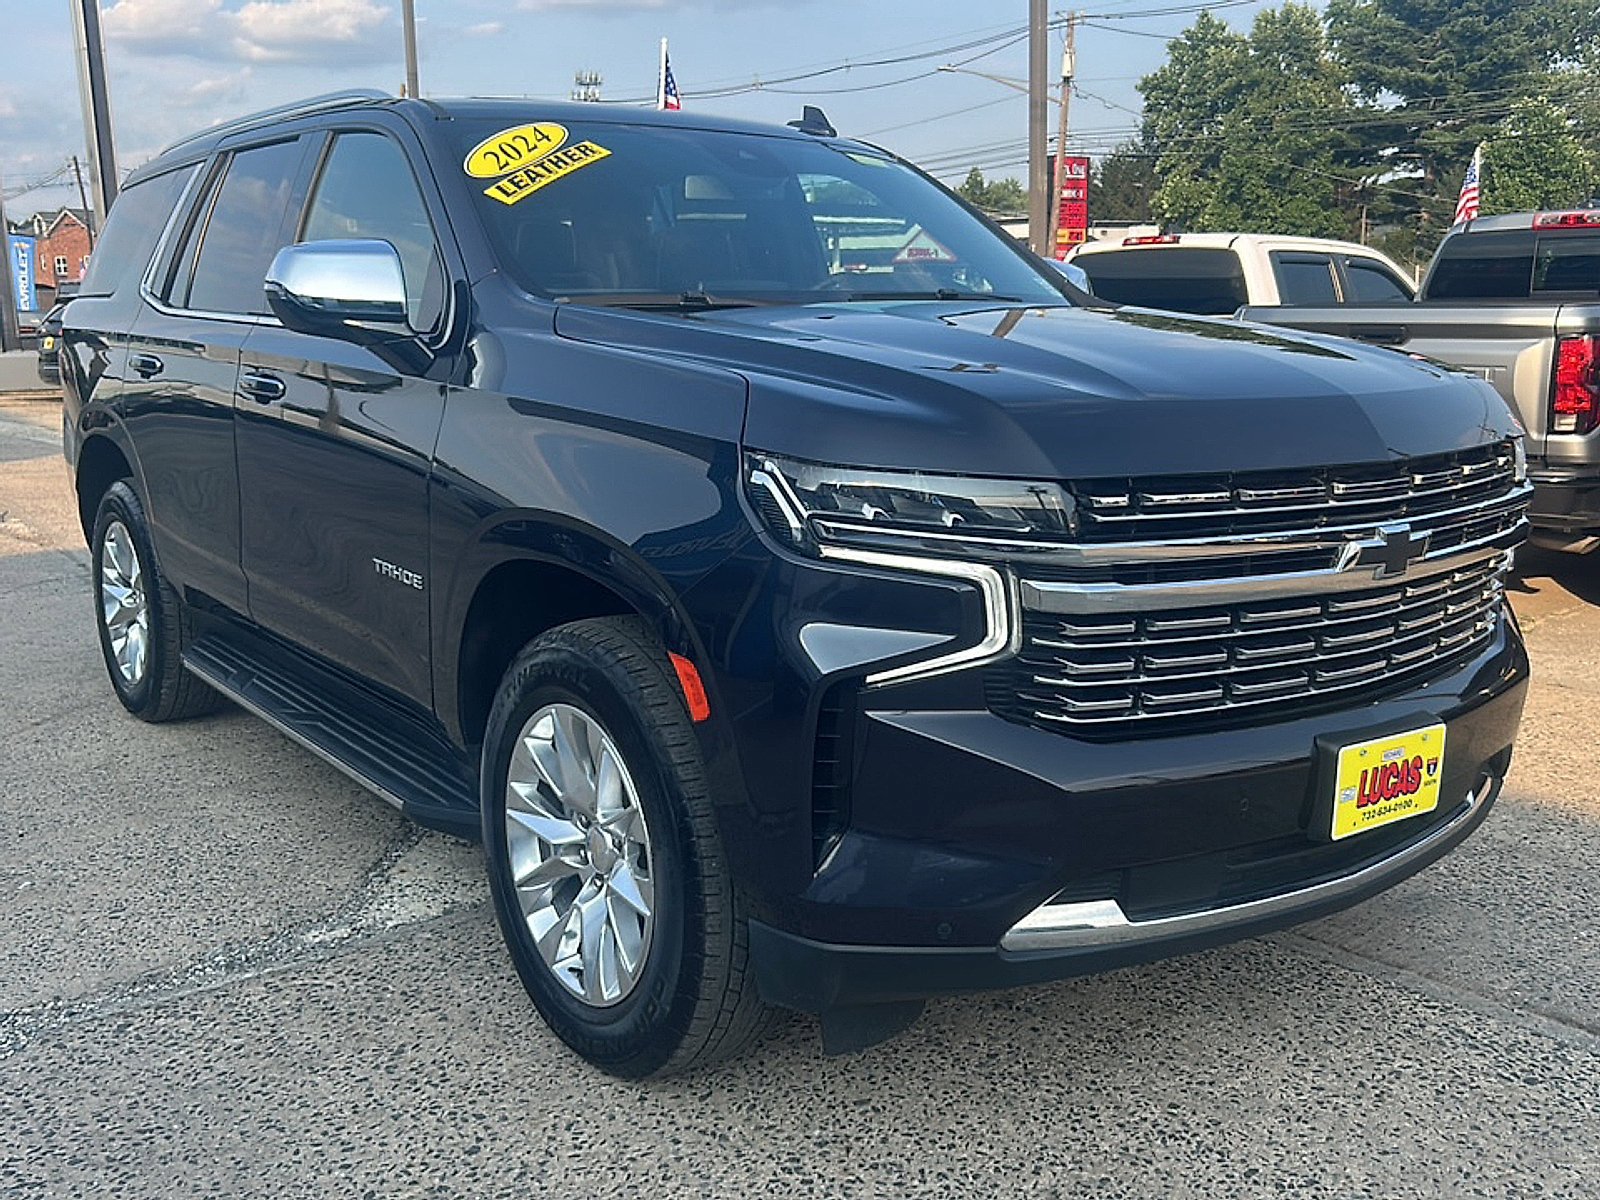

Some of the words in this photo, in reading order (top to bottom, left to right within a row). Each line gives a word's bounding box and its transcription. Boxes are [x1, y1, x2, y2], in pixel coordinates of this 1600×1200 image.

[483, 126, 552, 171] 2024
[495, 144, 598, 197] LEATHER
[18, 250, 30, 311] EVROLET
[372, 558, 424, 590] TAHOE
[1356, 755, 1424, 809] LUCAS
[1362, 799, 1413, 821] 732-634-0100
